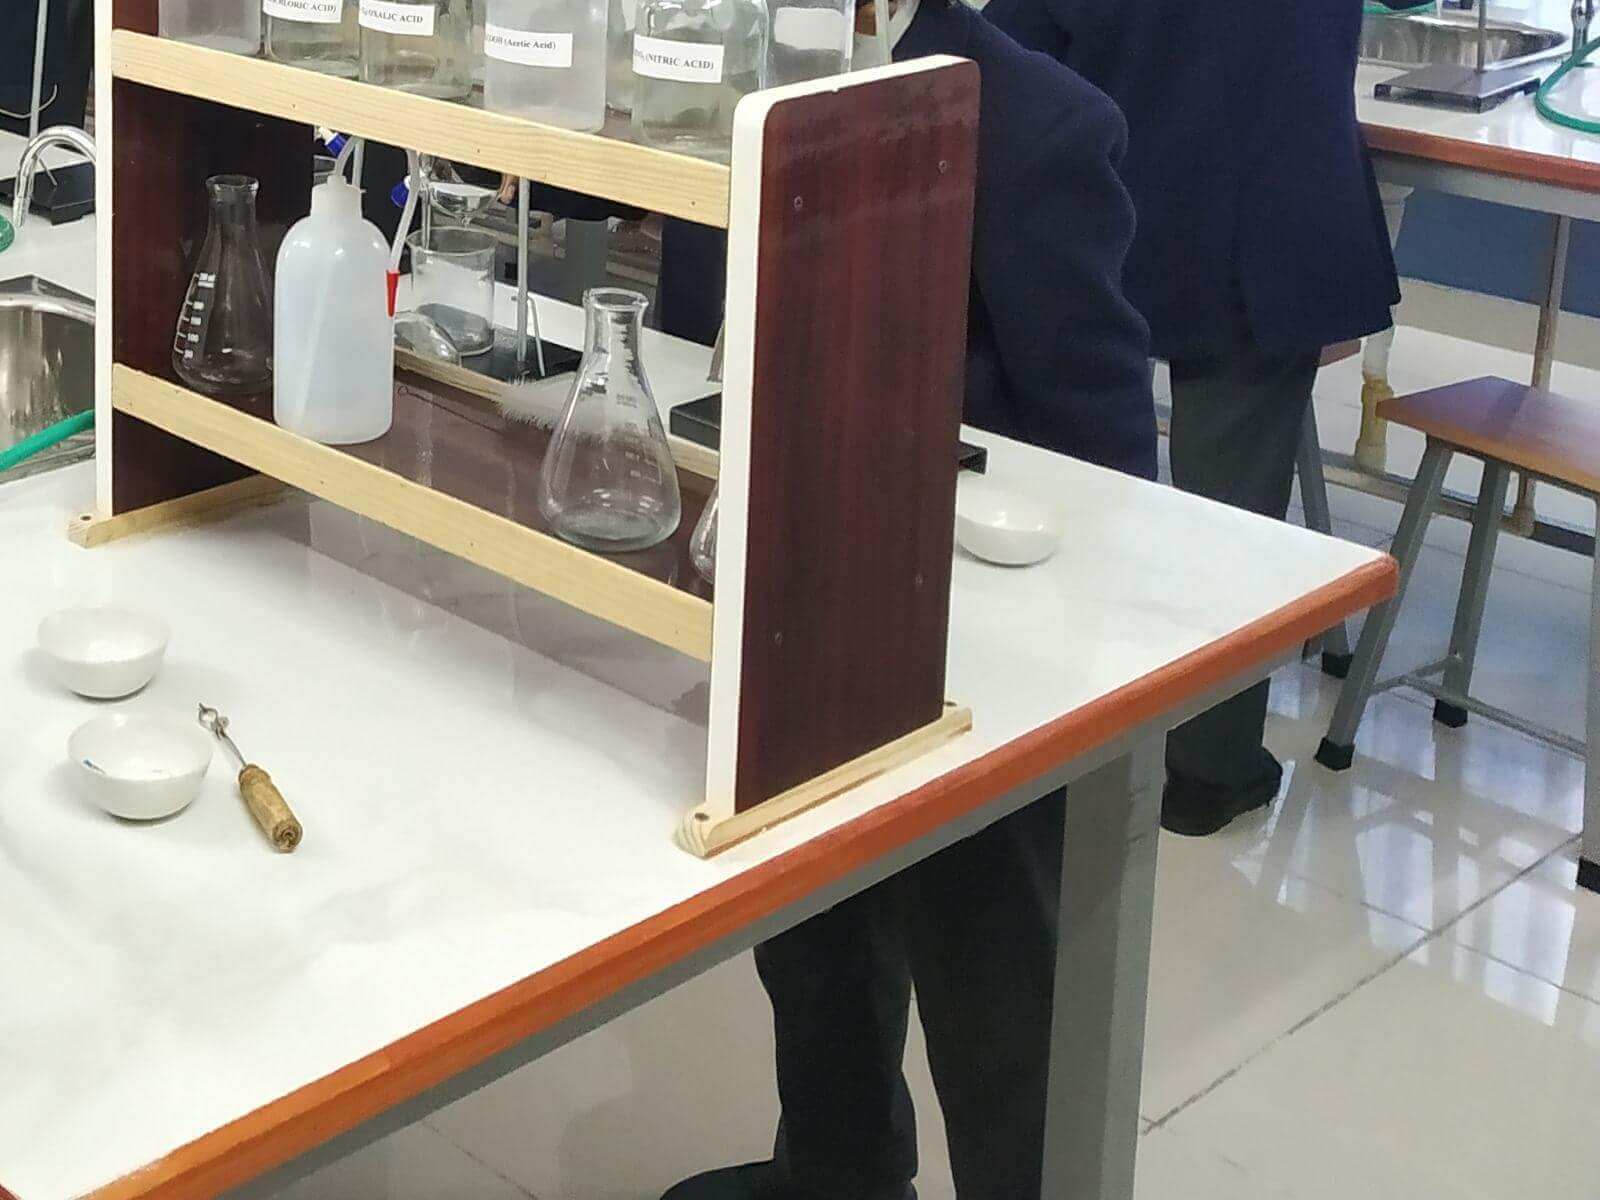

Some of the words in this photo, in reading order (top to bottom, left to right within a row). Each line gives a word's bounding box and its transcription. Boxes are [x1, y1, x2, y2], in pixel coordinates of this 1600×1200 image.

[311, 3, 336, 14] ACID)
[399, 14, 424, 24] ACID
[684, 59, 714, 71] ACID)
